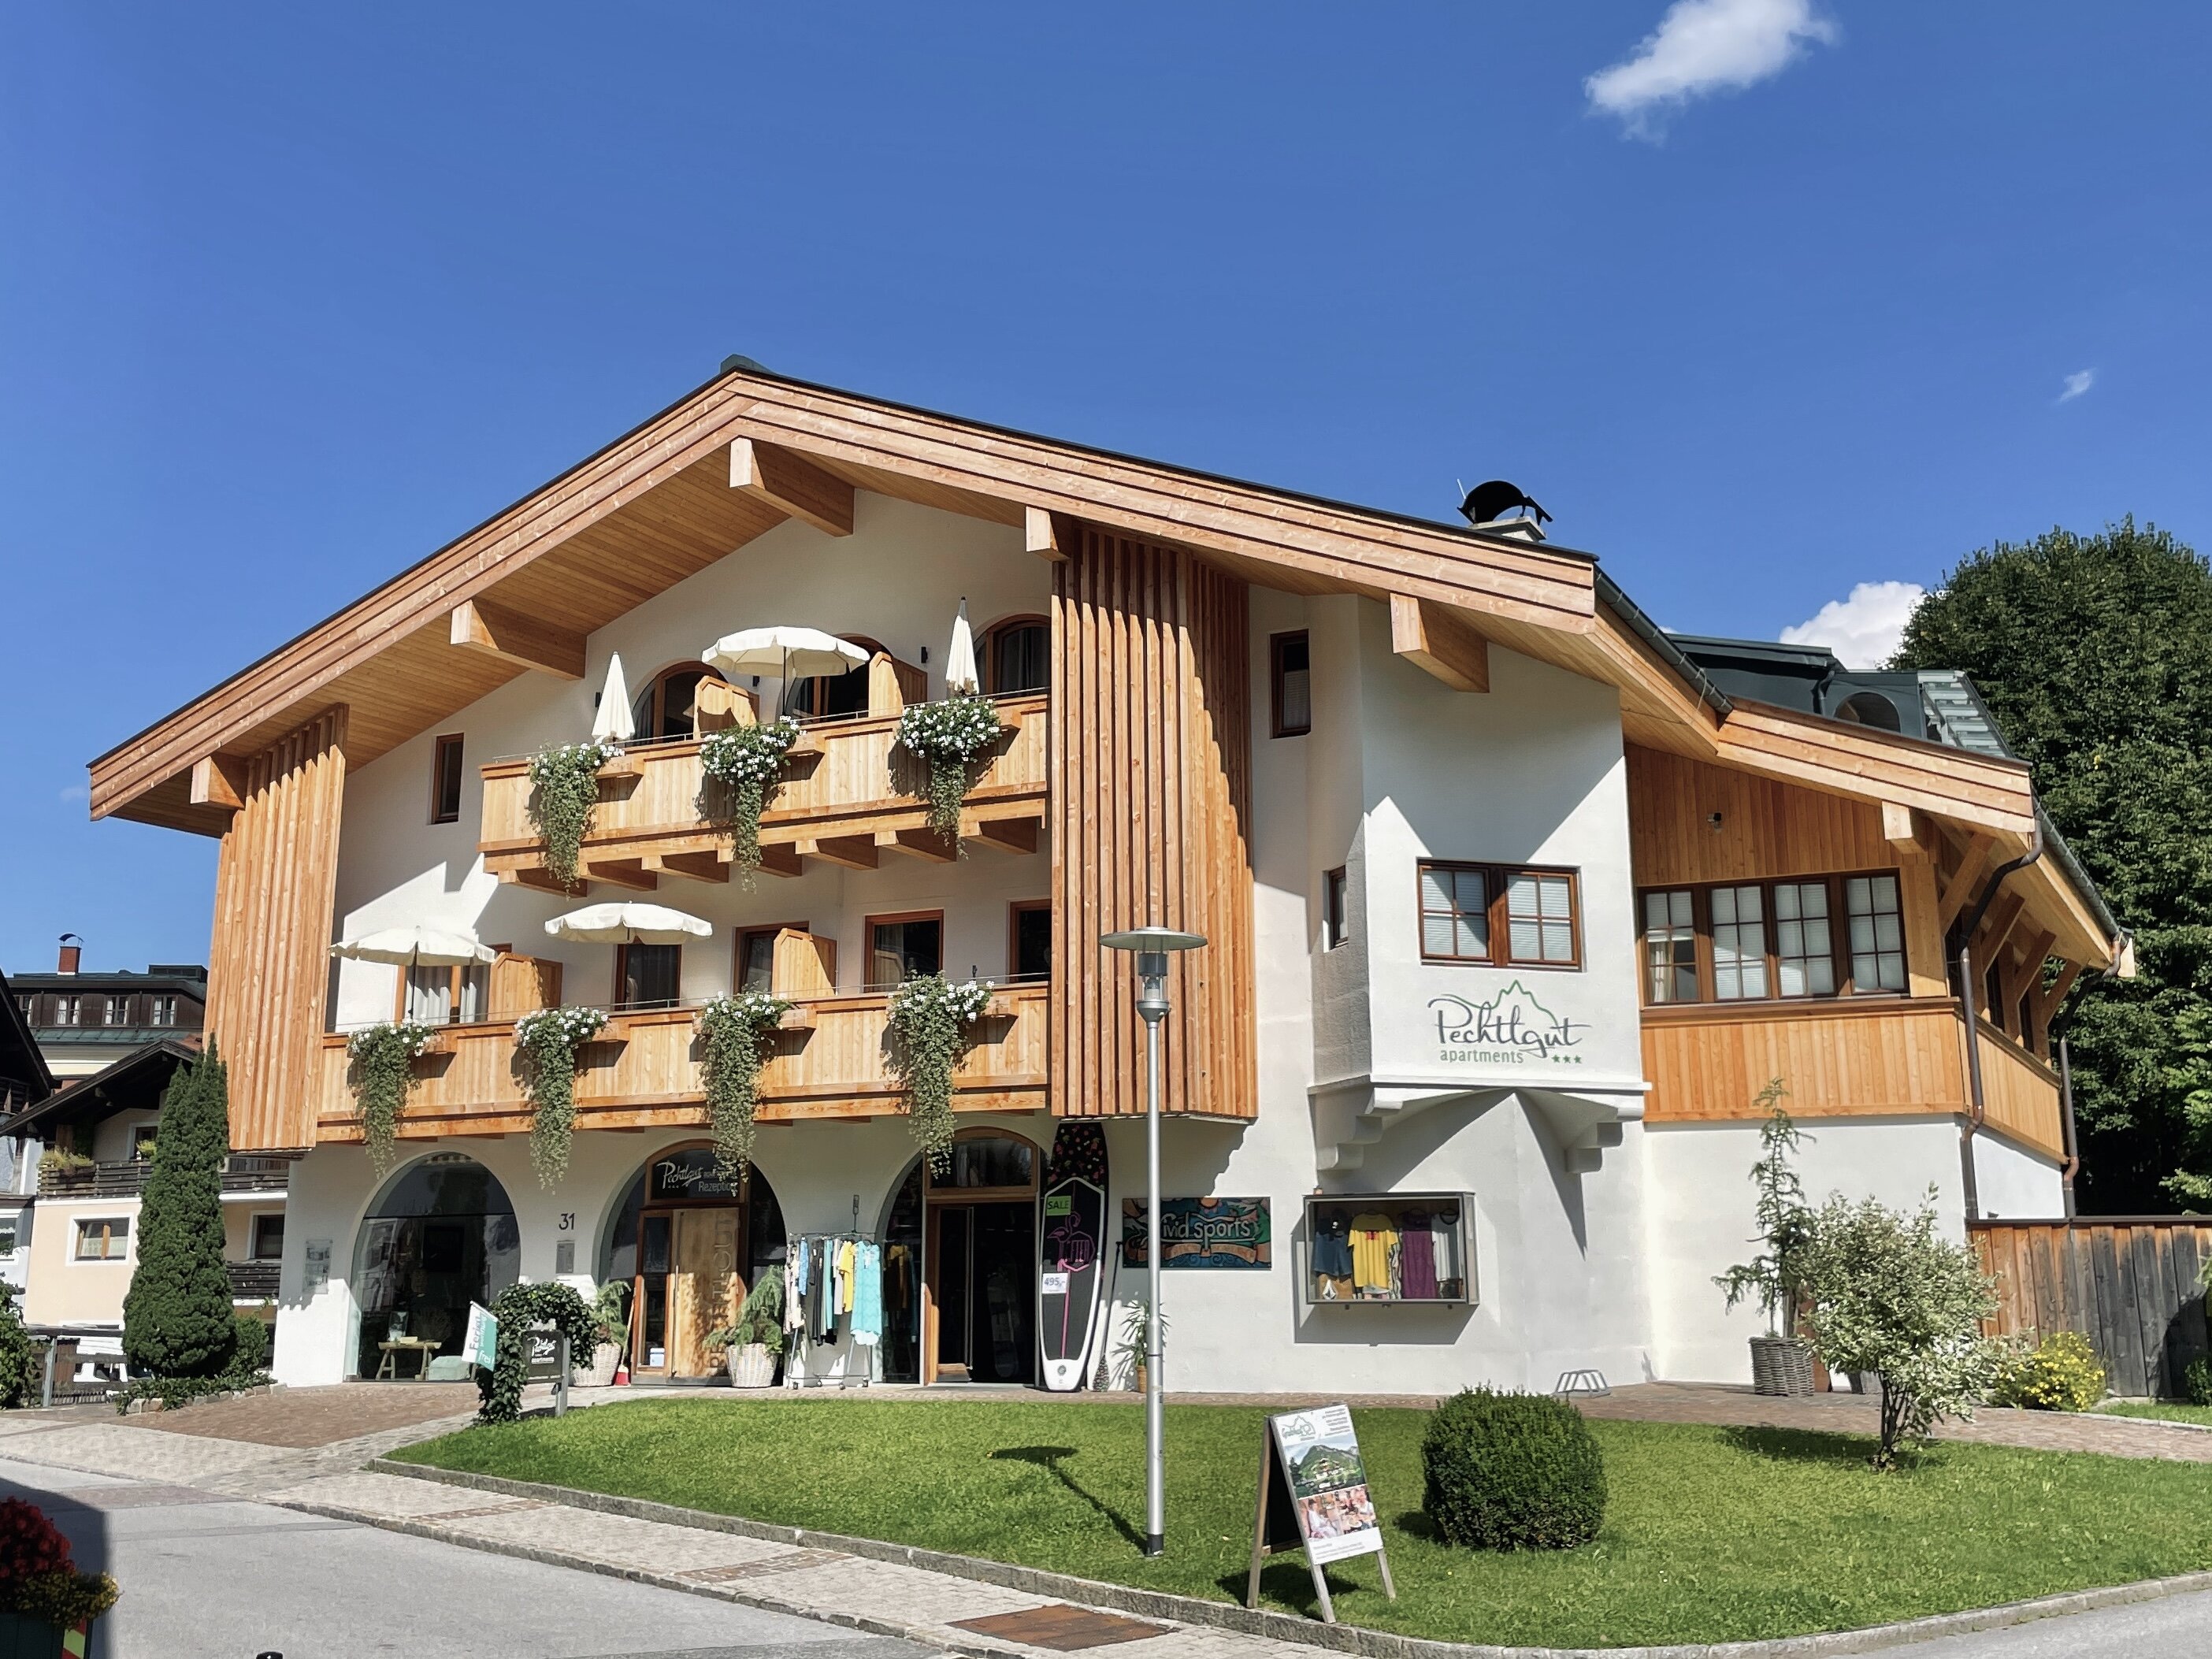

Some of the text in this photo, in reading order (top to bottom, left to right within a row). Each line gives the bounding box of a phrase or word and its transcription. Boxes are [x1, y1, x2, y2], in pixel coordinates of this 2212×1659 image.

[1427, 998, 1592, 1058] Pechtlgut
[1440, 1049, 1524, 1063] apartments
[1048, 1201, 1069, 1210] SALE
[559, 1213, 575, 1230] 31
[1193, 1217, 1251, 1249] sports
[1044, 1277, 1066, 1286] 495,-
